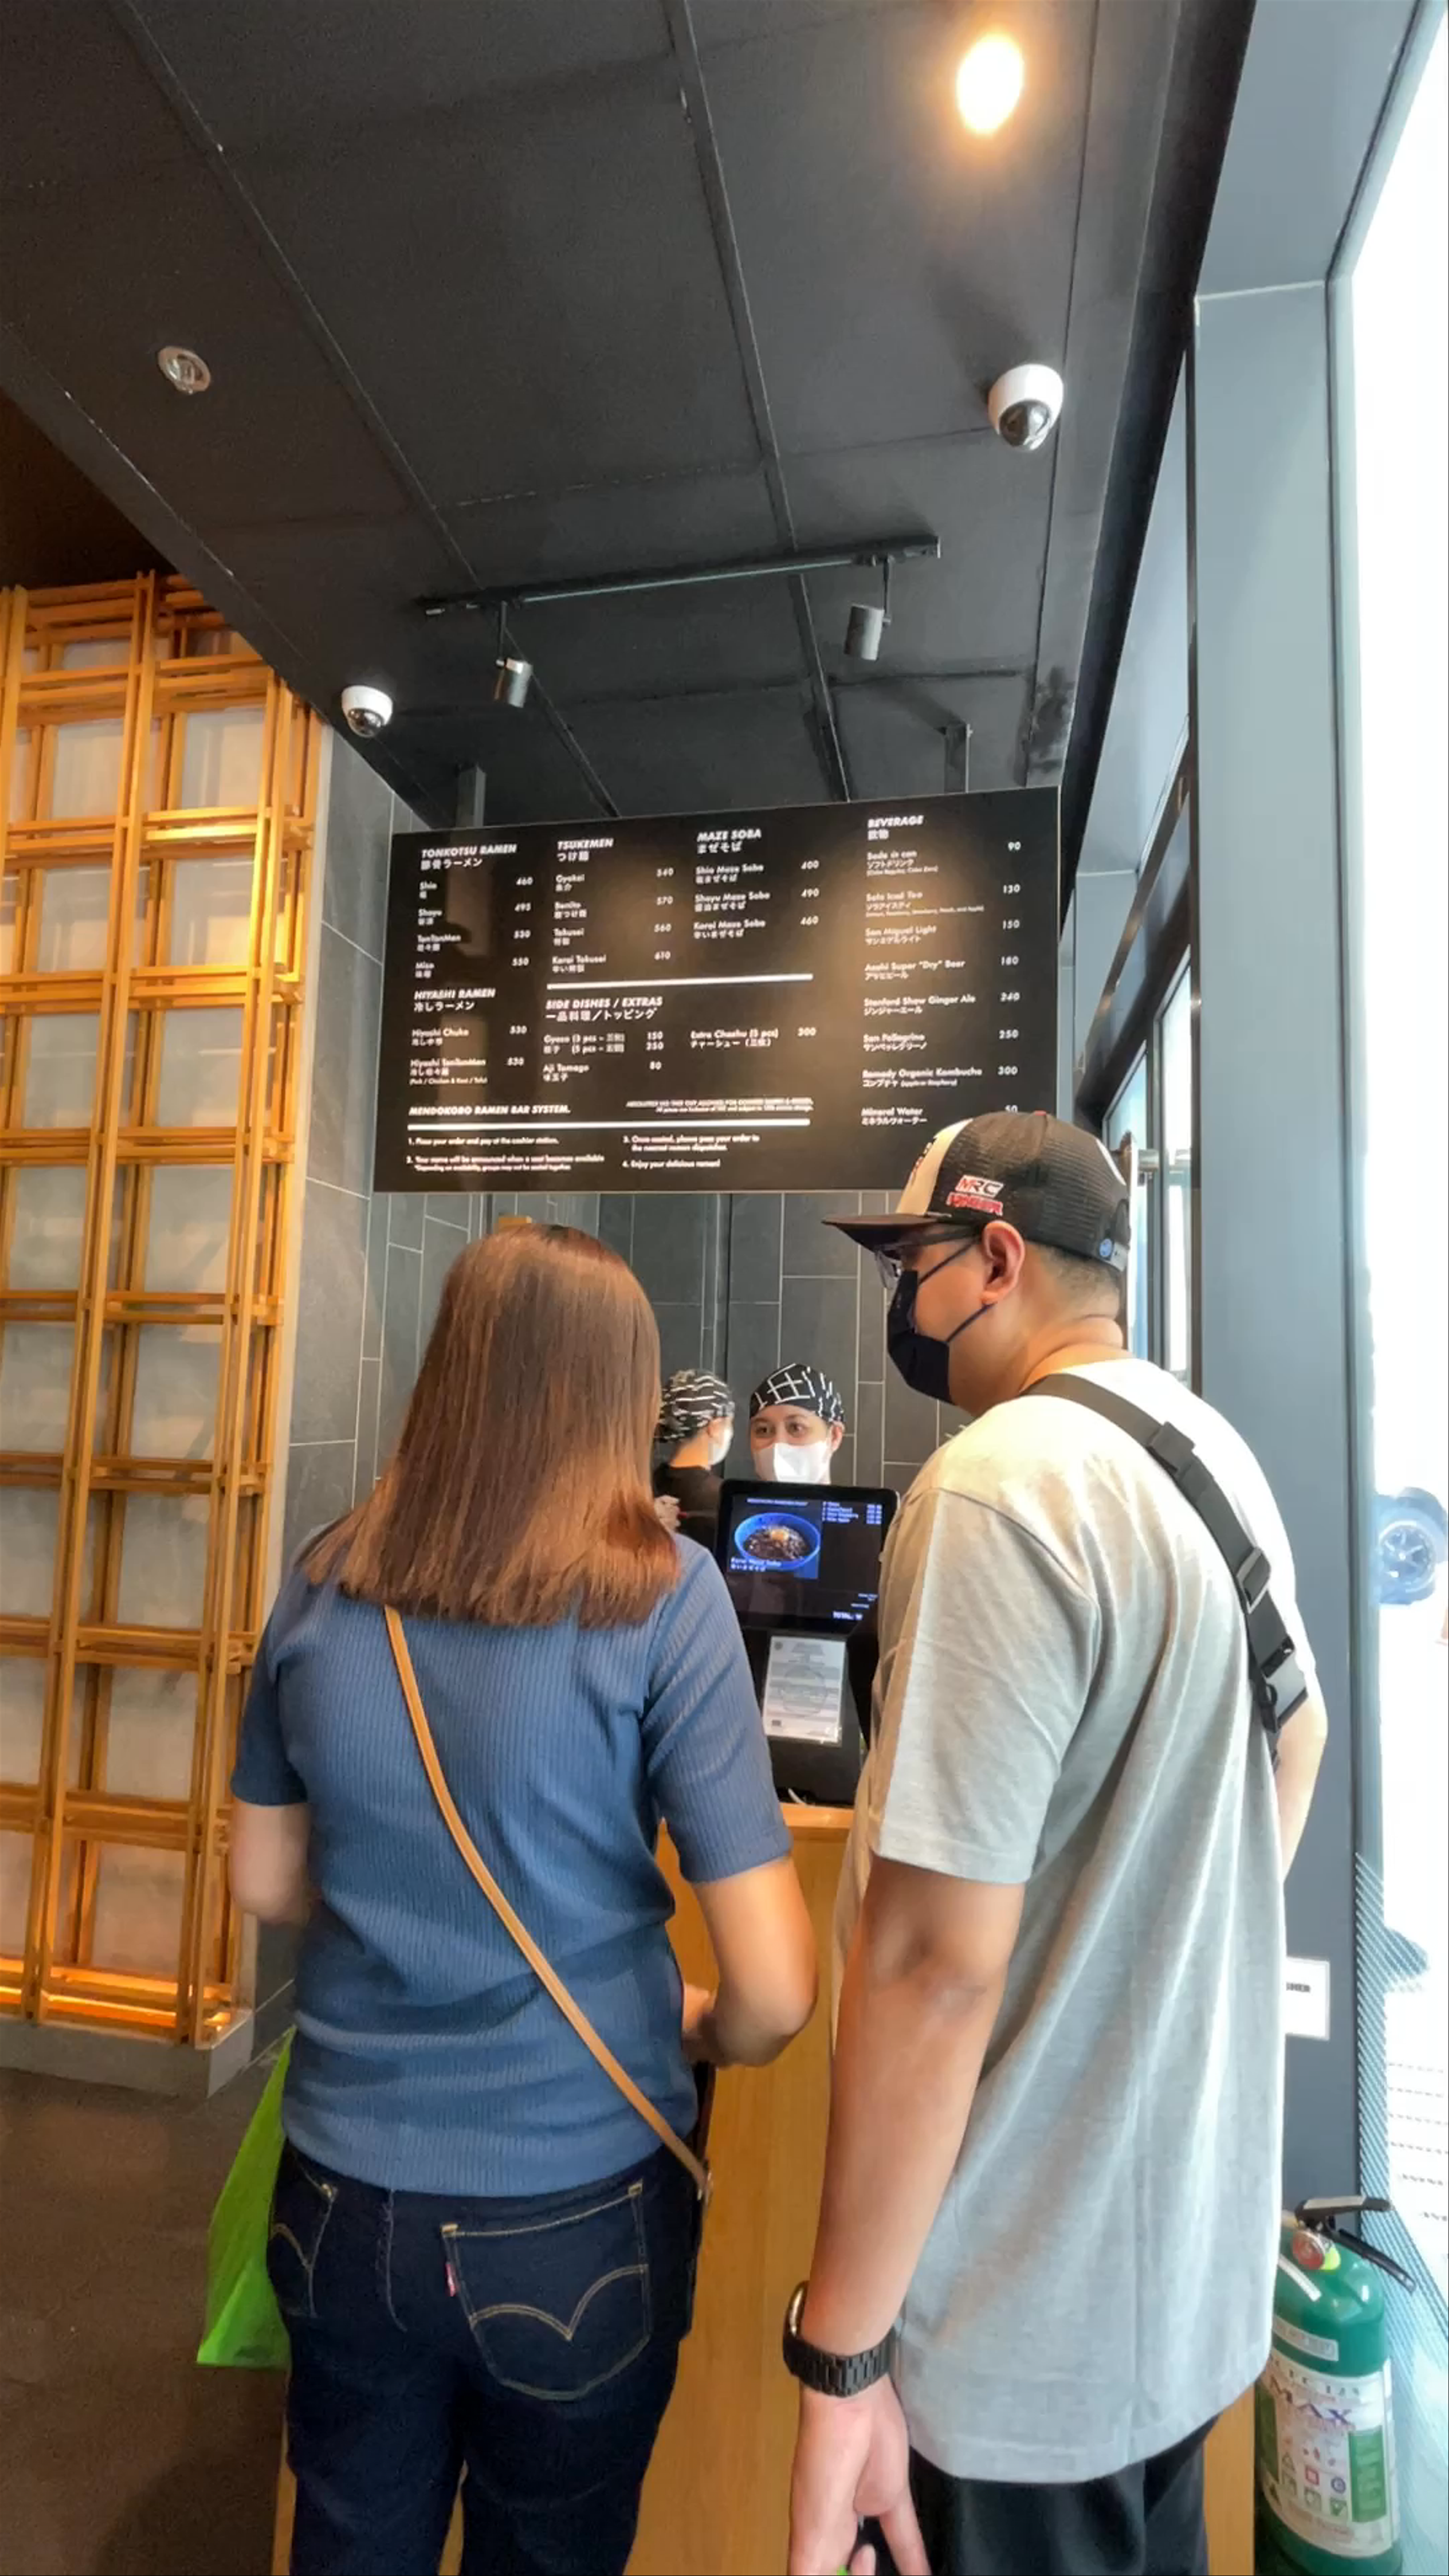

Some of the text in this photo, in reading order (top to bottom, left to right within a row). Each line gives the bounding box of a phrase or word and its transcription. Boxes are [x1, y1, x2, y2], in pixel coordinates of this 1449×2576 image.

[868, 815, 924, 828] BEVERAGE
[697, 828, 762, 842] MAZE SOBA
[557, 838, 614, 850] TSUKEMEN
[697, 841, 742, 854] まぜそば
[1008, 841, 1021, 851] 90
[421, 843, 518, 858] TONKOTSU RAMEN
[656, 867, 674, 877] 540
[696, 863, 764, 875] Shio Maze Soba
[420, 881, 437, 890] Shio
[516, 877, 534, 886] 460
[801, 888, 820, 898] 490
[1003, 884, 1020, 894] 130
[695, 894, 721, 903] Shoyu
[748, 890, 771, 900] Soba
[907, 890, 923, 899] Tea
[656, 896, 674, 906] 570
[418, 908, 443, 917] Shoyu
[744, 918, 766, 928] Soba
[800, 915, 819, 925] 460
[1003, 919, 1020, 930] 150
[865, 924, 937, 937] San Miguel Light
[415, 961, 434, 969] Miso
[864, 962, 889, 972] Asahi
[891, 961, 916, 971] Super
[944, 959, 966, 969] Beer
[414, 988, 496, 1000] HIYASHI RAMEN
[928, 995, 959, 1005] Ginger
[960, 993, 976, 1003] Ale
[546, 1000, 570, 1010] SIDE
[572, 998, 611, 1009] DISHES
[622, 997, 663, 1007] EXTRAS
[412, 1026, 469, 1038] Hiyashi Chuka
[647, 1031, 663, 1040] 150
[691, 1030, 712, 1039] Extra
[999, 1029, 1019, 1039] 250
[863, 1032, 925, 1043] San Pellegrino
[410, 1059, 440, 1068] Hiyashi
[543, 1063, 590, 1074] Aji Tamago
[649, 1061, 661, 1070] 80
[898, 1067, 934, 1079] Organic
[935, 1066, 982, 1077] Kombucha
[997, 1066, 1018, 1075] 300
[408, 1105, 571, 1116] MENDOKORO RAMEN BAR SYSTEM.
[861, 1107, 923, 1117] Mineral Water
[448, 1137, 466, 1145] order
[732, 1134, 751, 1143] order
[631, 1159, 649, 1169] Enjoy
[666, 1159, 695, 1168] delicious
